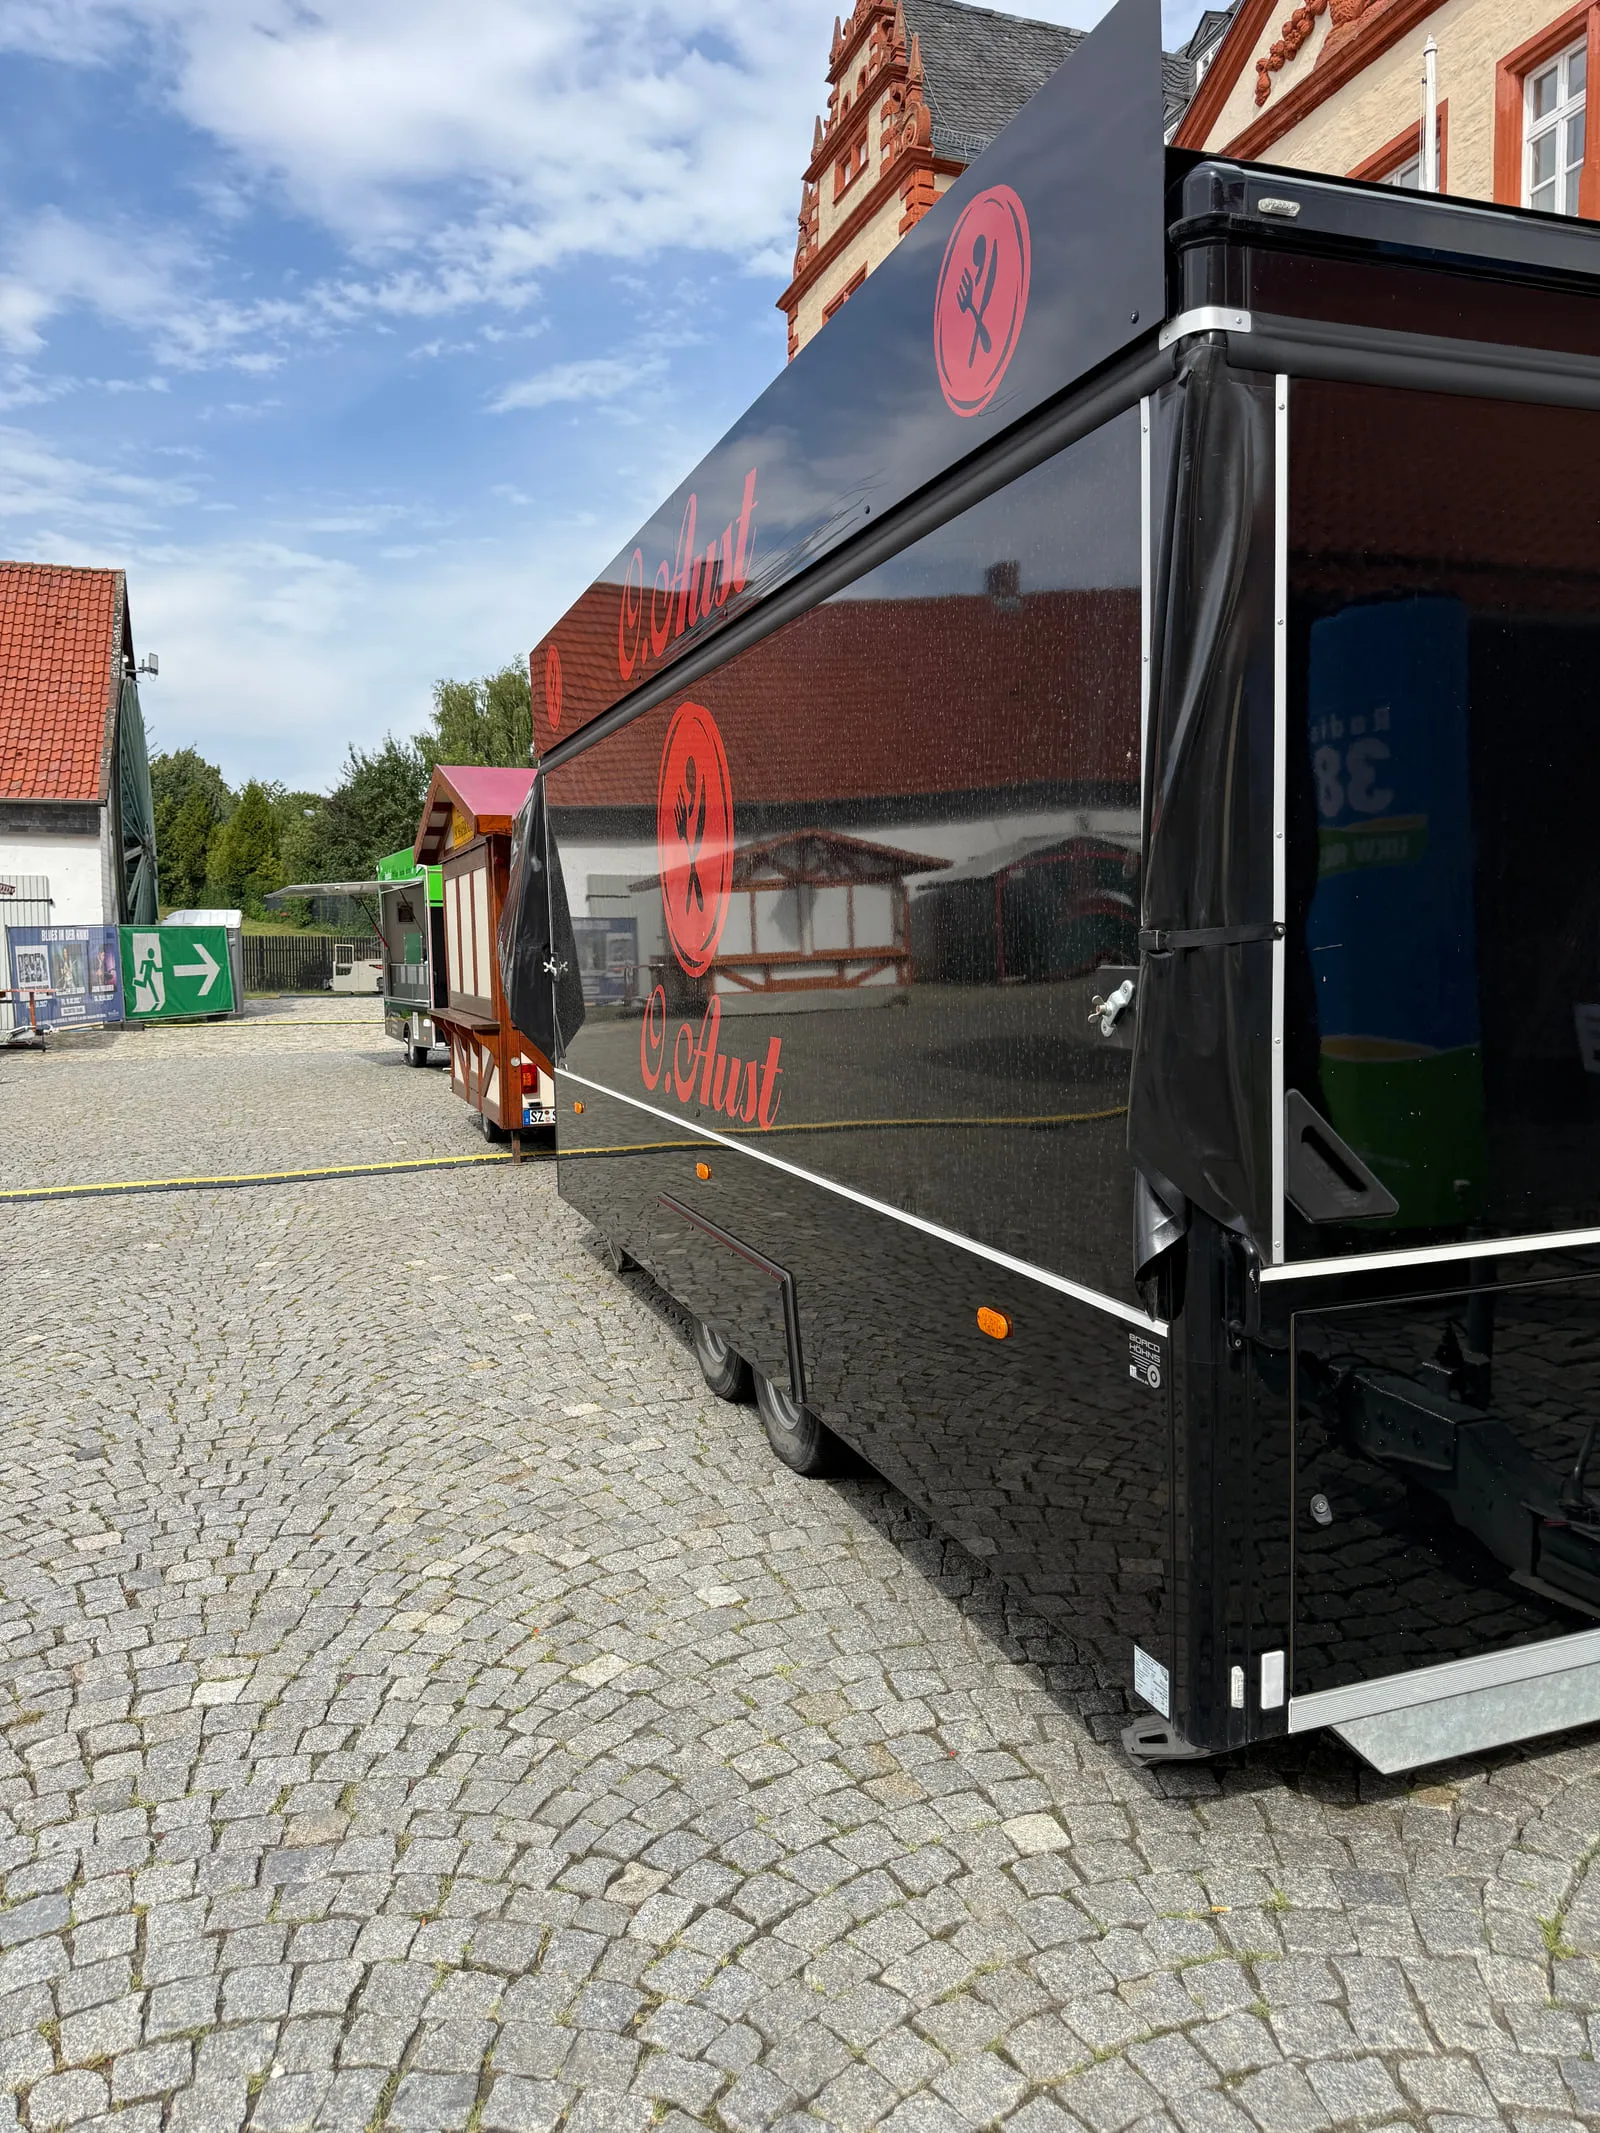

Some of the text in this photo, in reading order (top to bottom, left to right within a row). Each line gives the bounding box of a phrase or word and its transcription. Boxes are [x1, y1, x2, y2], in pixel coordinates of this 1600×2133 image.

[531, 1110, 545, 1123] SZ
[1129, 1333, 1160, 1353] BORCO
[1129, 1342, 1161, 1364] HÖHNS
